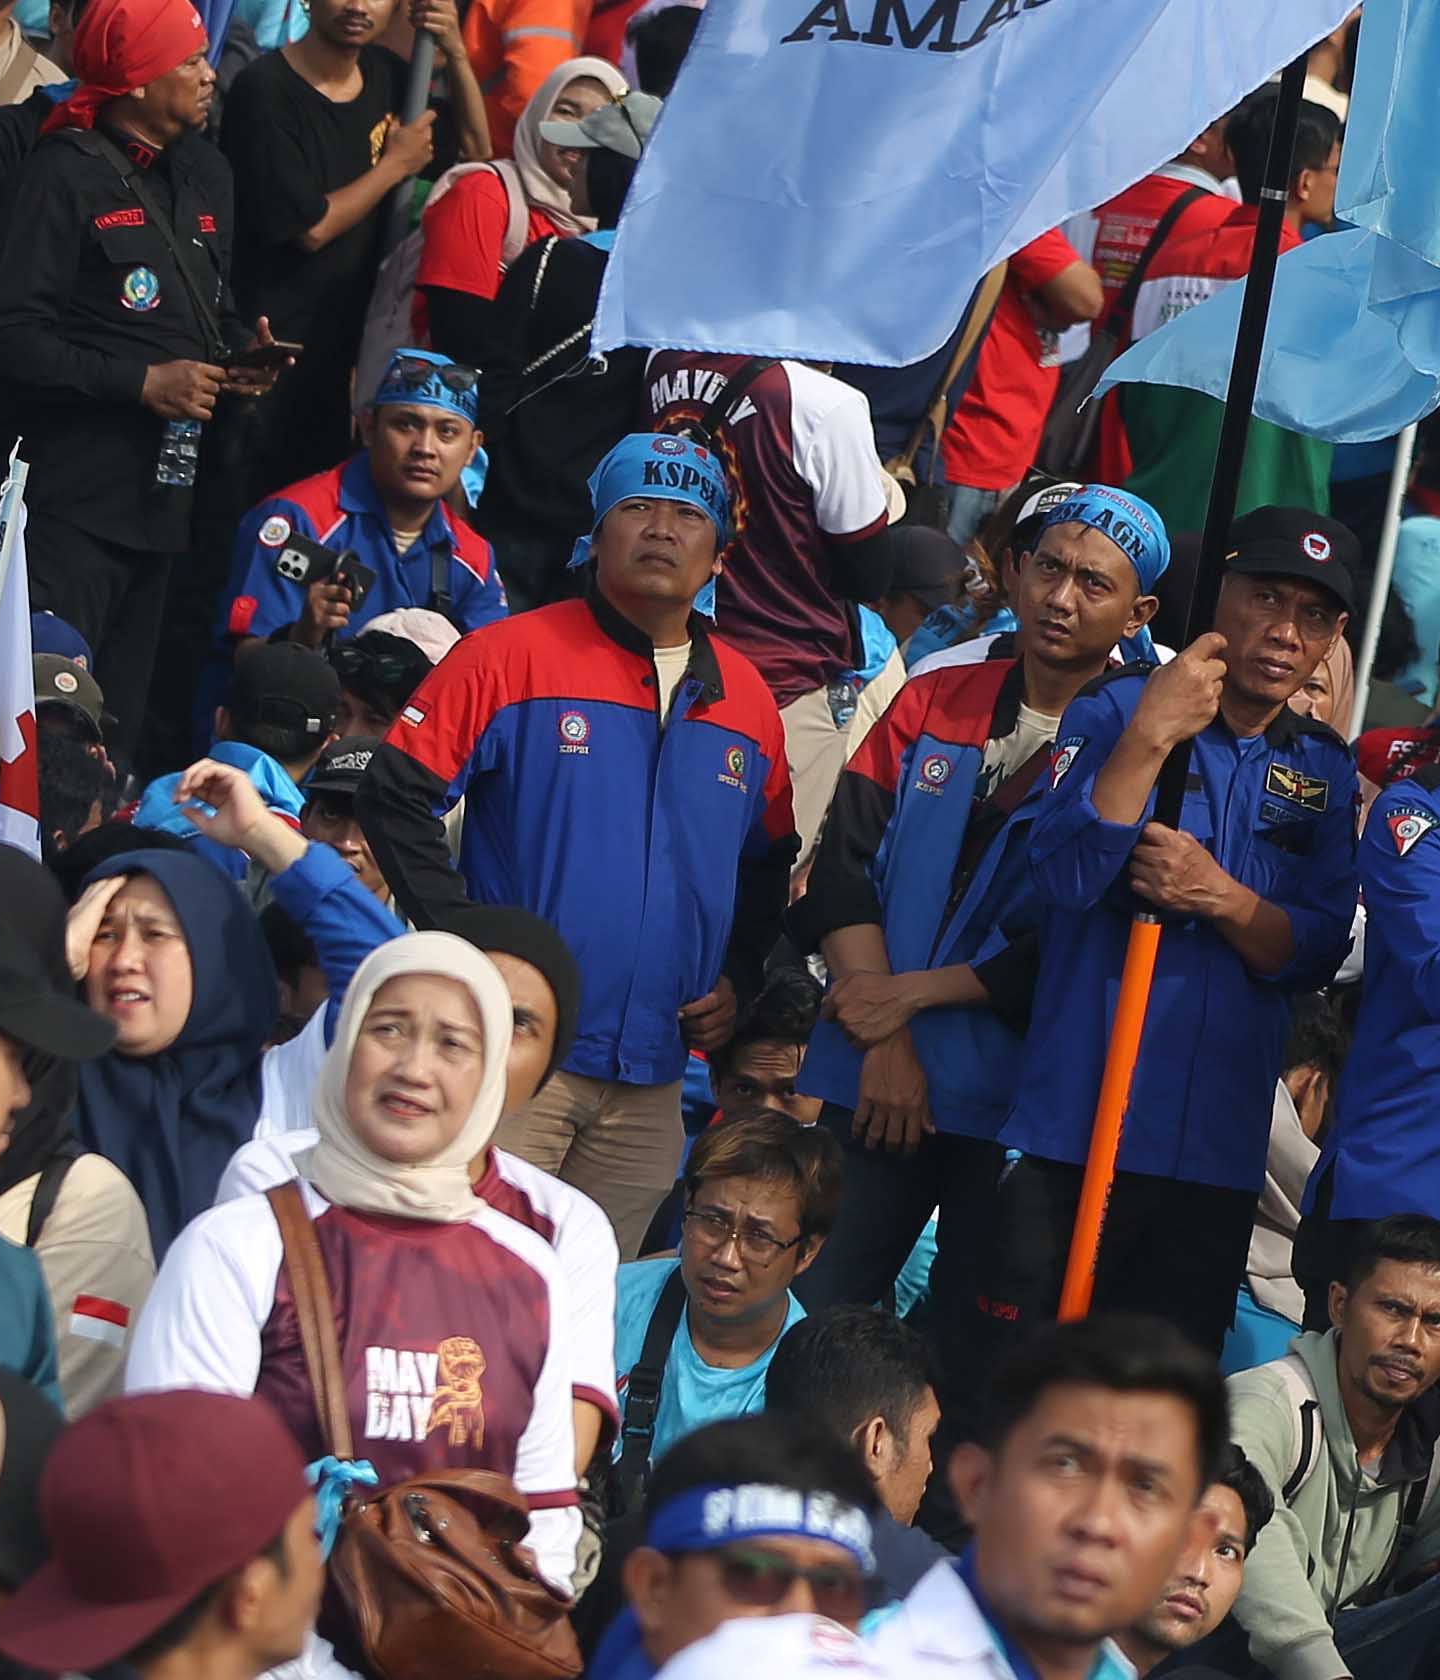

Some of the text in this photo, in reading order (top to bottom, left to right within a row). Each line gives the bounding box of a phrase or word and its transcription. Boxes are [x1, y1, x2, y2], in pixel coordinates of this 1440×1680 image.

[650, 367, 758, 427] MAYDY
[1092, 500, 1148, 559] AGN
[364, 1344, 441, 1398] MAY
[364, 1393, 438, 1444] DAY
